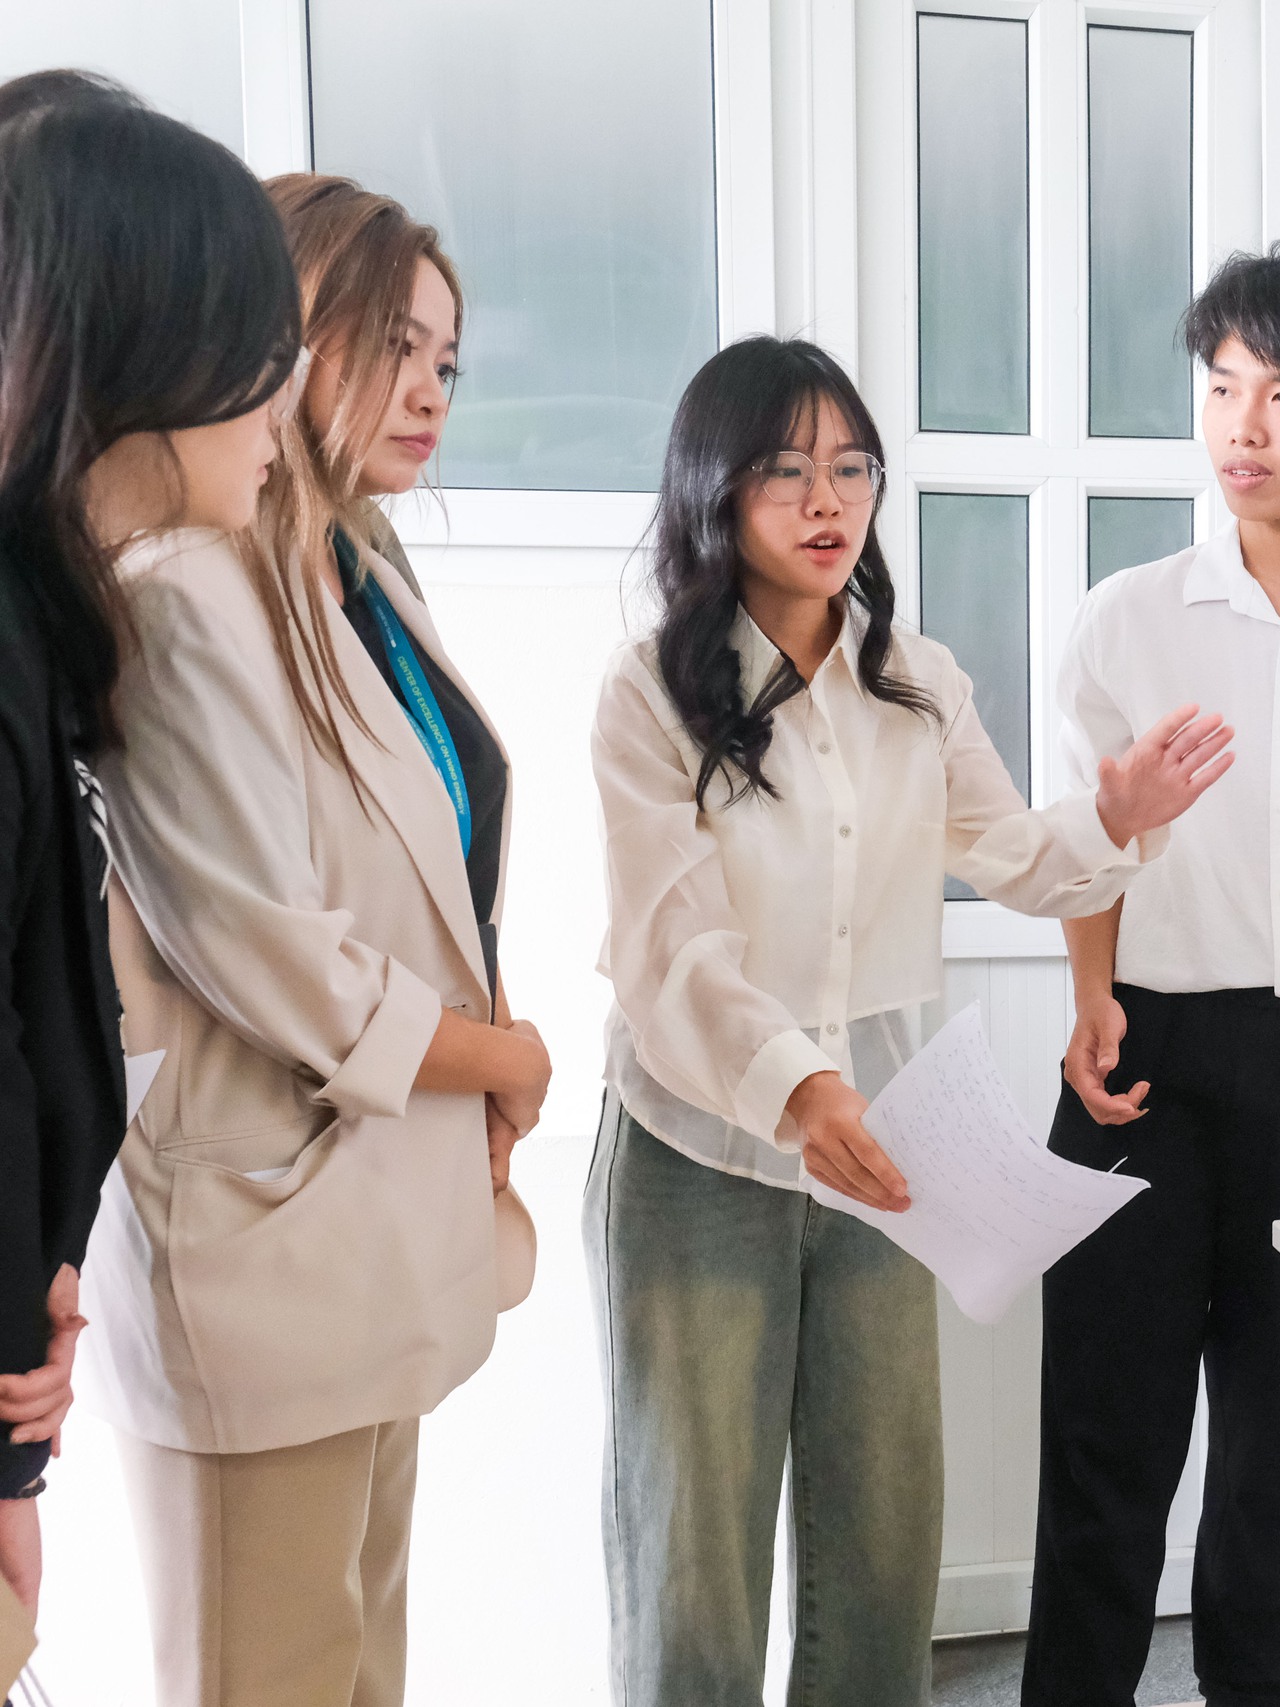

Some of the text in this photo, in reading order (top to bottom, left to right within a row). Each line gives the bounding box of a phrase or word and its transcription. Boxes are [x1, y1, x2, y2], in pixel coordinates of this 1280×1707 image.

[397, 656, 465, 815] CENTER OF EXCELLENCE ON WIND ENERGY
